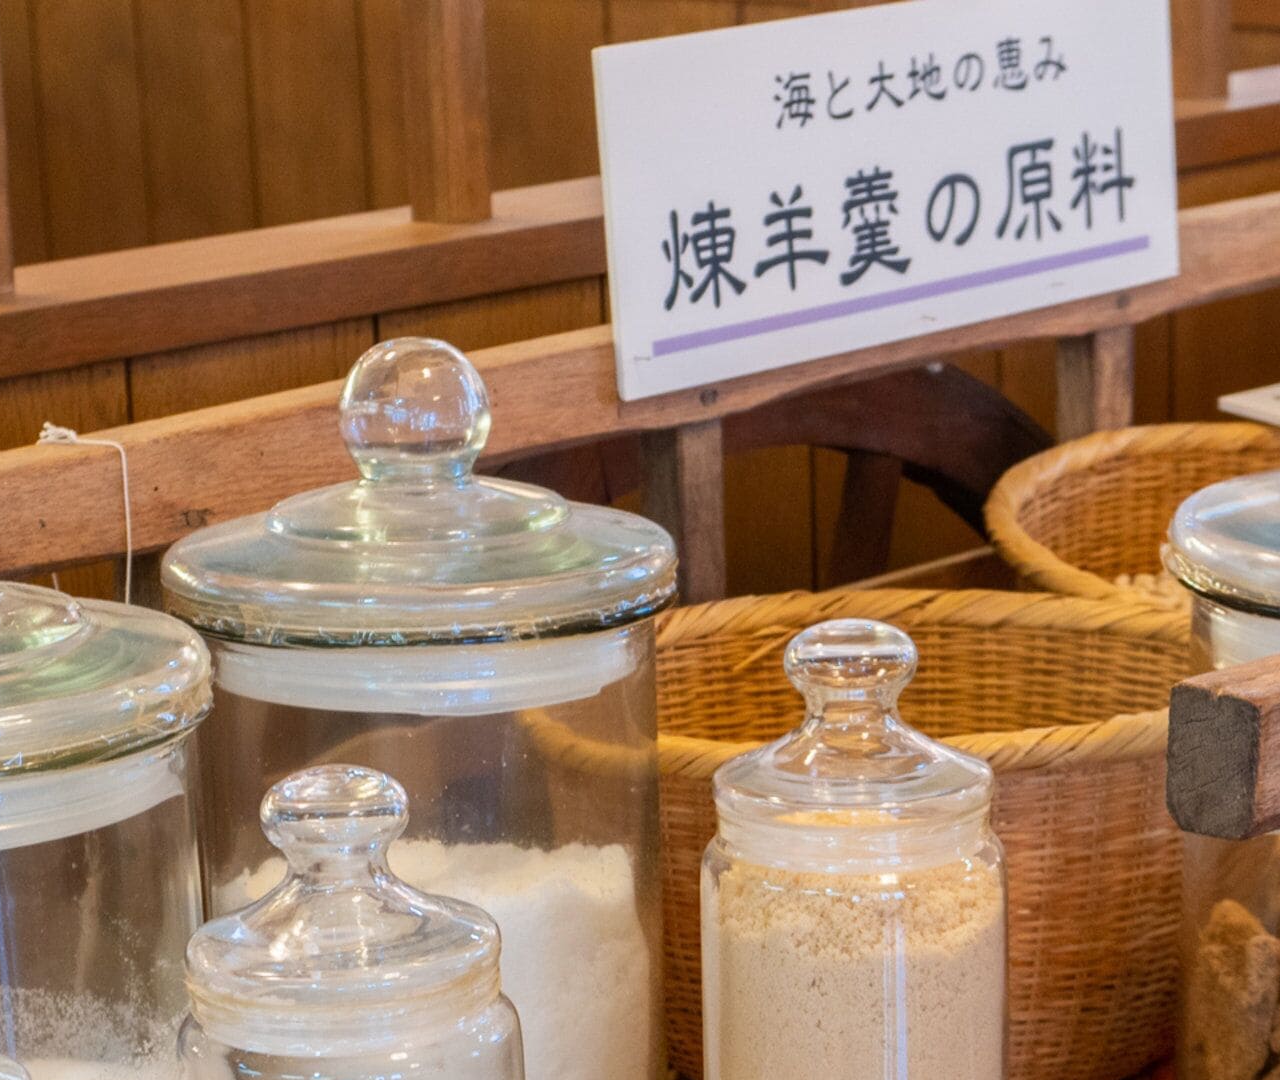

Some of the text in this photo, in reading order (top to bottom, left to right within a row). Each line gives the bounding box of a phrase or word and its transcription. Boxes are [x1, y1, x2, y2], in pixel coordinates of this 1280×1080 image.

[773, 36, 1068, 129] 海と大地の恵み
[662, 127, 1137, 310] 煉羊羹の原料
